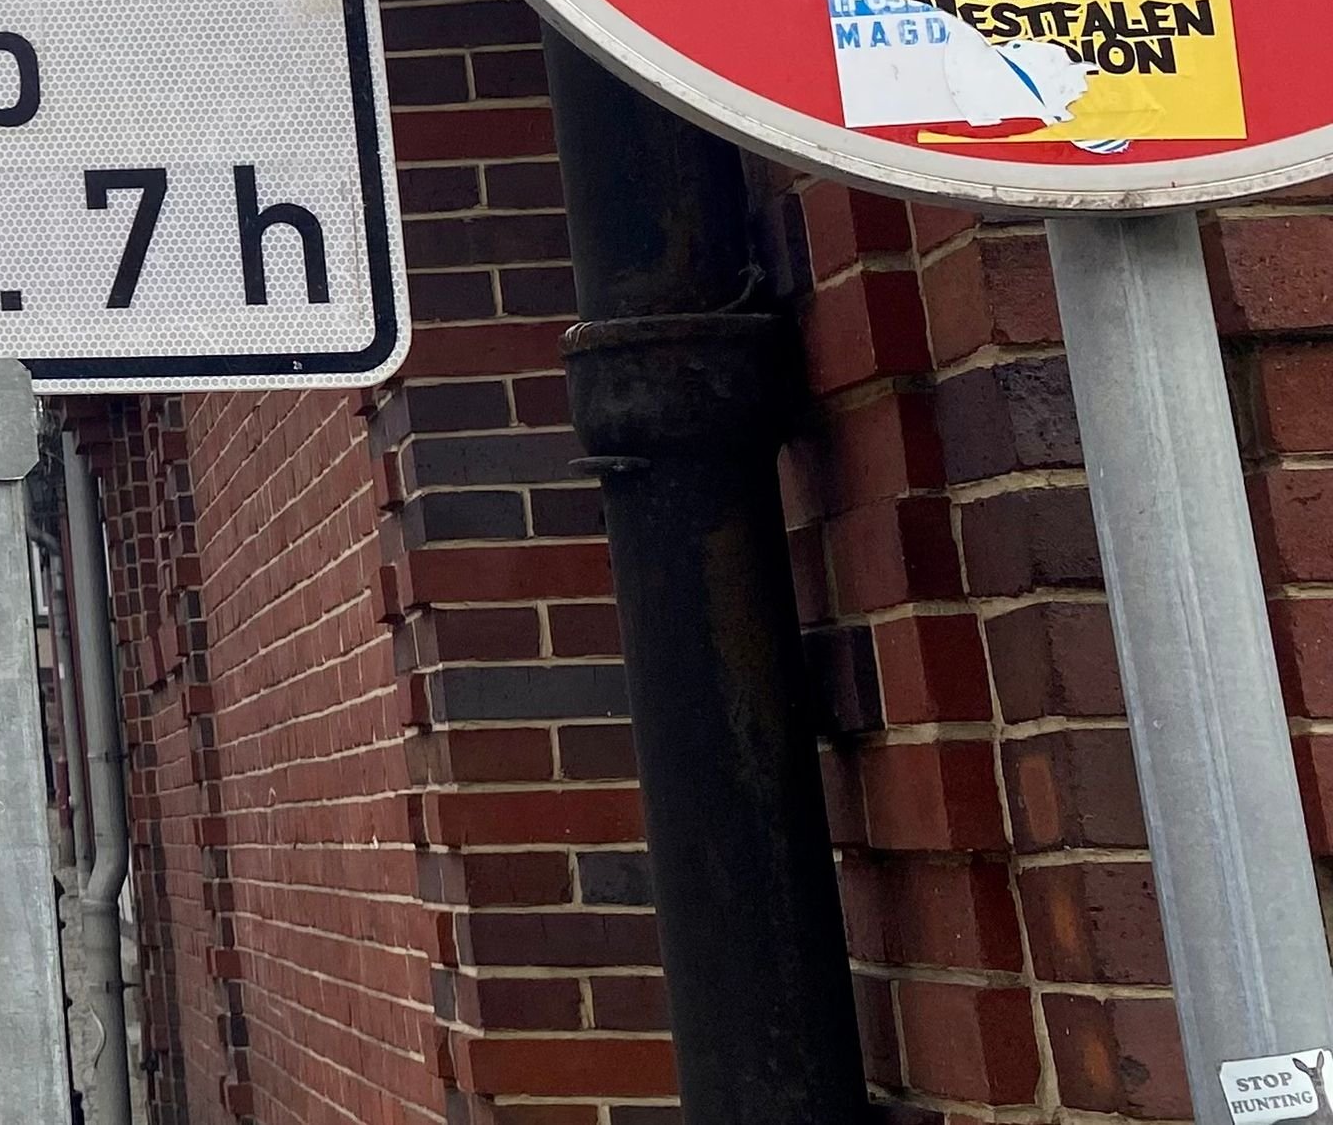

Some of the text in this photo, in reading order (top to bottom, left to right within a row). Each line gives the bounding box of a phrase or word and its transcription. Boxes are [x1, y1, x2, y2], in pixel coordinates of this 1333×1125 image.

[83, 167, 168, 309] 7
[233, 164, 331, 306] h
[1236, 1071, 1293, 1092] STOP
[1231, 1091, 1314, 1114] HUNTING
